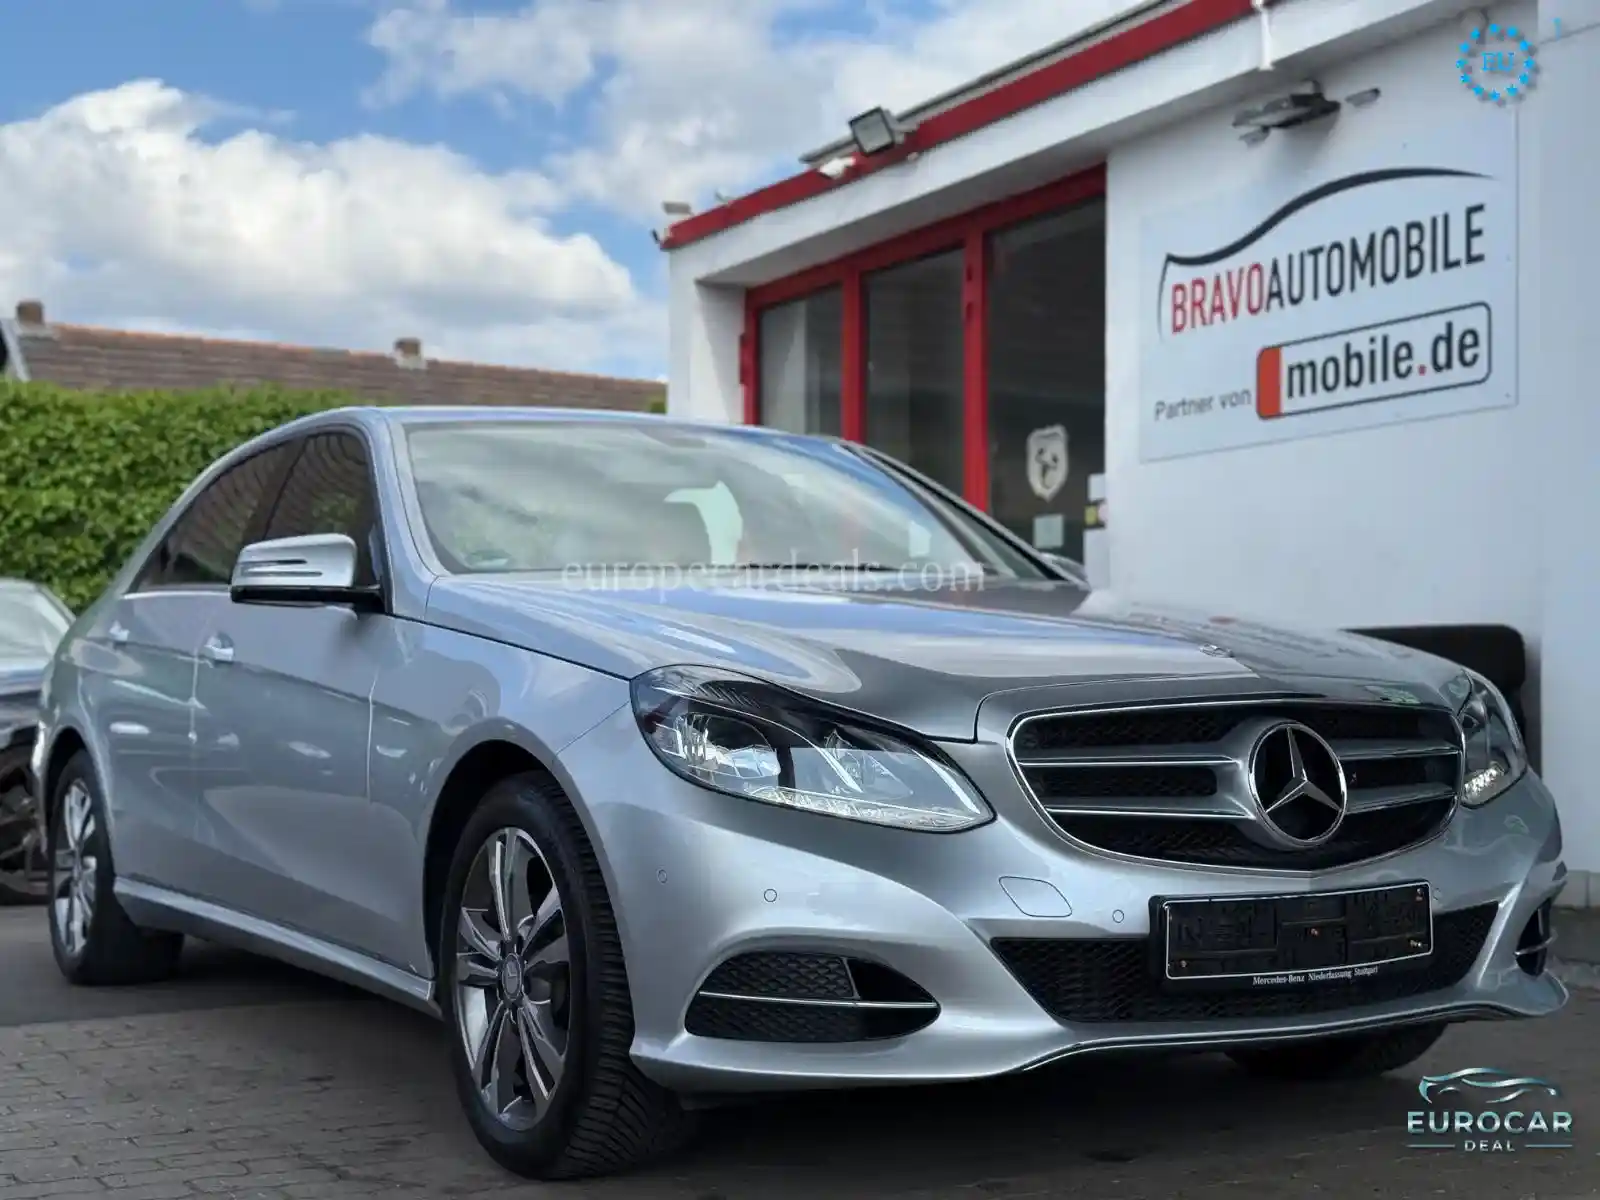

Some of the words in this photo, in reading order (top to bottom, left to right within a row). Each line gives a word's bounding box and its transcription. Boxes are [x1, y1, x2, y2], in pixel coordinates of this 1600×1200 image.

[1154, 396, 1214, 421] Partner
[1219, 389, 1252, 409] von
[1286, 321, 1480, 399] mobile.de
[1252, 975, 1305, 985] Mercedes-Benz
